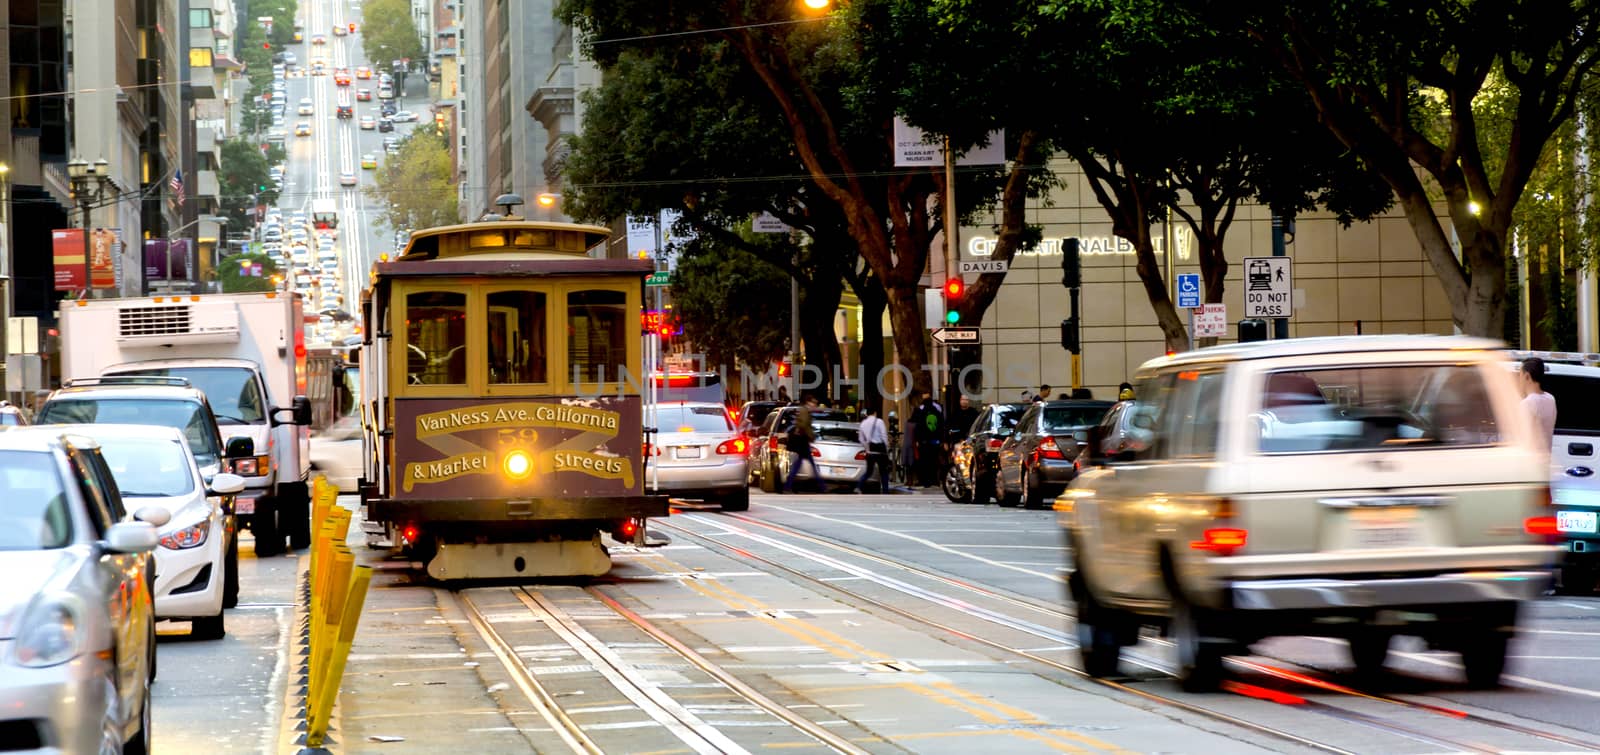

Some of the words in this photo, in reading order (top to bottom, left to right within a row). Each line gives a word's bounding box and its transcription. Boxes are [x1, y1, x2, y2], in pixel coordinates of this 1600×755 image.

[963, 262, 1004, 272] DAVIS
[1248, 293, 1263, 303] DO
[1268, 292, 1288, 302] NOT
[1255, 305, 1282, 315] PASS
[420, 416, 449, 431] Van
[450, 409, 489, 426] Ness
[536, 406, 617, 429] California
[496, 428, 539, 446] 59
[413, 465, 425, 479] &
[428, 454, 488, 478] Market
[554, 452, 623, 474] Streets
